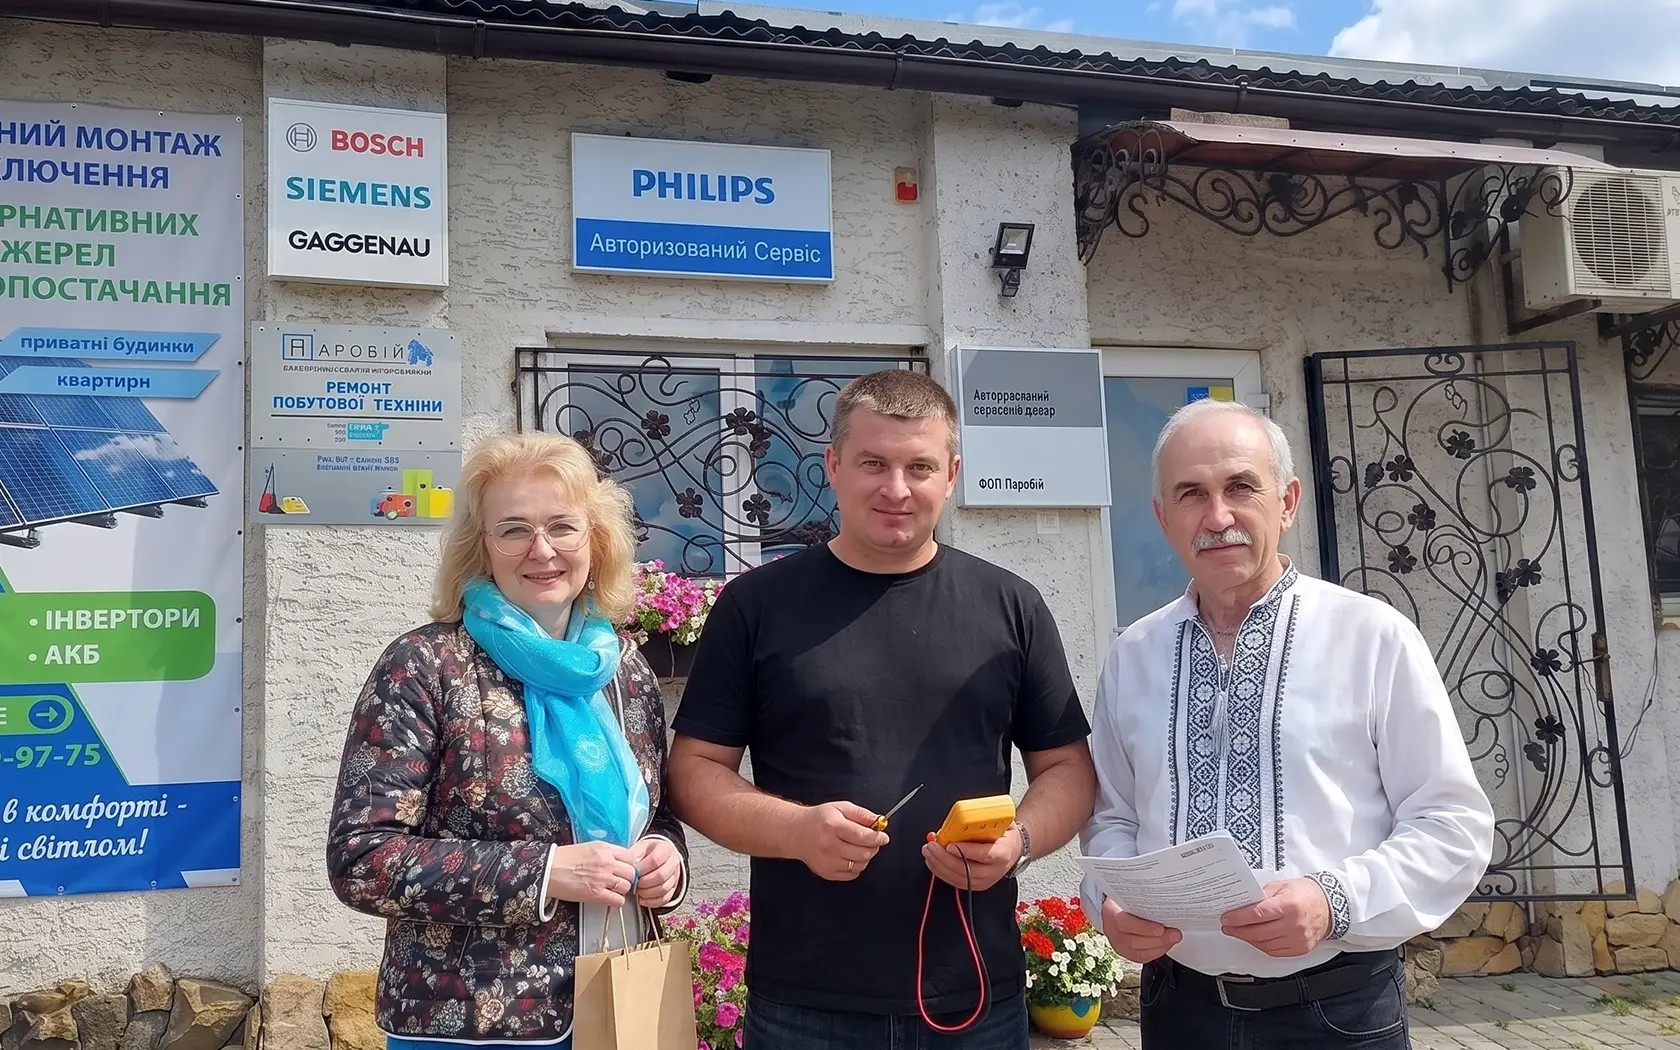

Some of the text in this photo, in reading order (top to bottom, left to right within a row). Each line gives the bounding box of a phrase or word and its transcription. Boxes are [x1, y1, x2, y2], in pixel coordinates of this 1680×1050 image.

[76, 126, 221, 157] МОНТАЖ
[331, 129, 424, 158] BOSCH
[0, 158, 169, 189] ЛЮЧЕННЯ
[632, 168, 776, 206] PHILIPS
[286, 176, 431, 210] SIEMENS
[0, 205, 199, 237] РНАТИВНИХ
[0, 240, 115, 268] ЖЕРЕЛ
[288, 229, 431, 258] GAGGENAU
[590, 232, 821, 266] Авторизований Сервіс
[0, 276, 231, 307] ПОСТАЧАННЯ
[20, 335, 195, 357] приватні будинки
[326, 381, 392, 395] РЕМОНТ
[273, 396, 365, 410] ПОБУТОВОЇ
[978, 478, 1044, 492] ФОП Паробій
[46, 608, 200, 630] ІНВЕРТОРИ
[44, 644, 100, 665] АКБ
[0, 743, 101, 769] -97-75
[3, 798, 19, 824] в
[25, 793, 169, 829] комфорті
[0, 828, 150, 862] і світлом!
